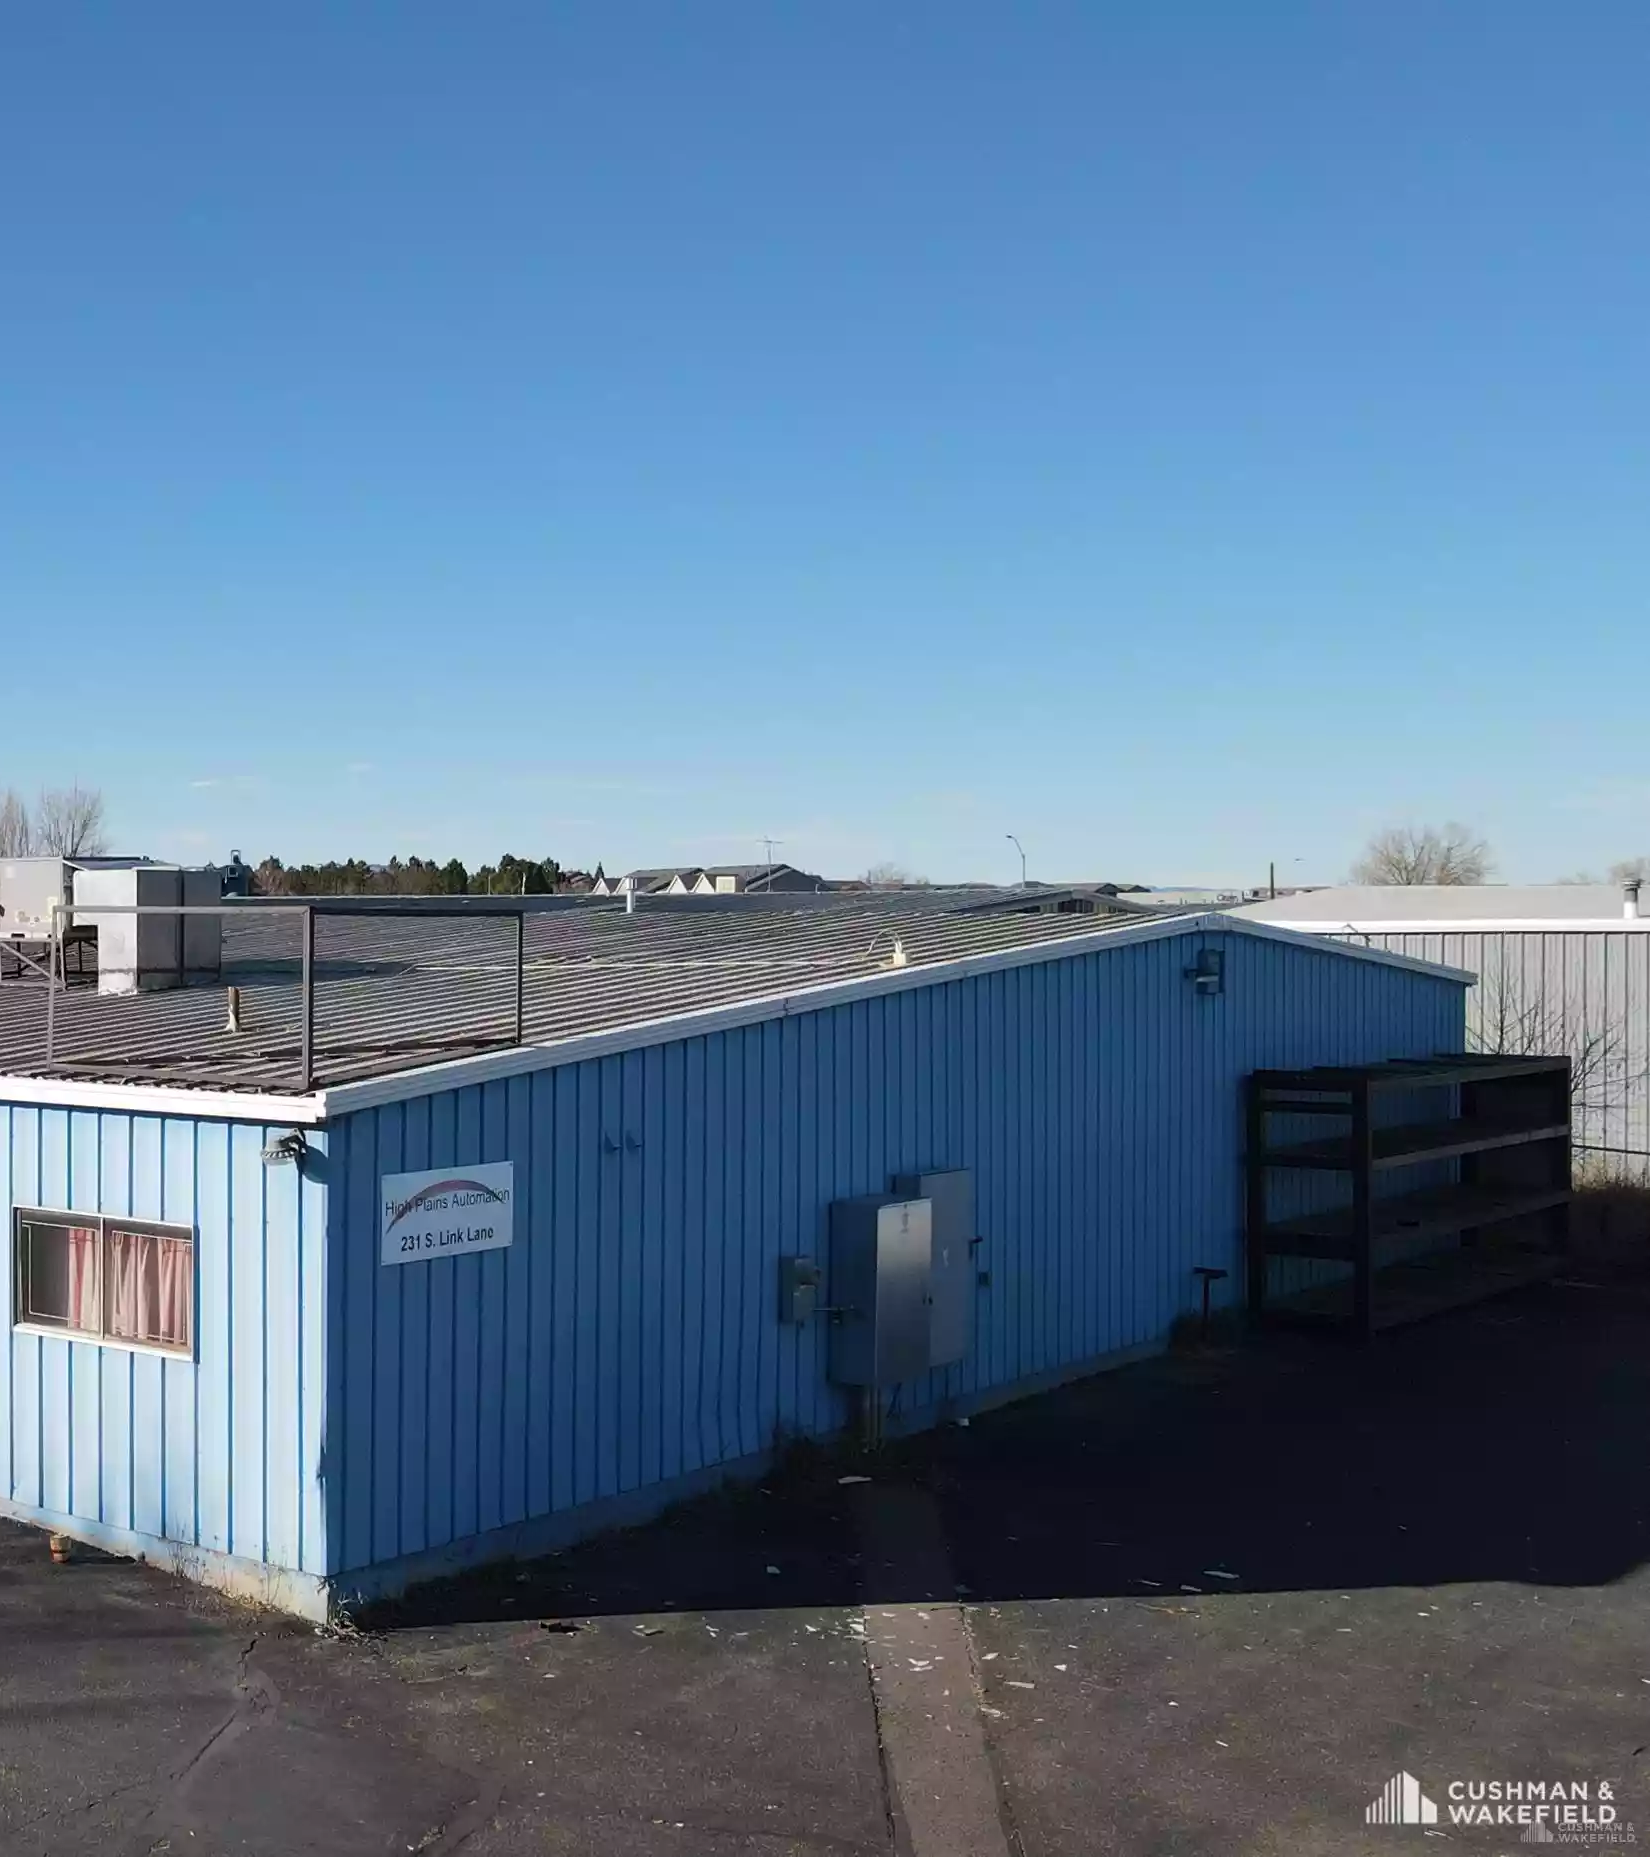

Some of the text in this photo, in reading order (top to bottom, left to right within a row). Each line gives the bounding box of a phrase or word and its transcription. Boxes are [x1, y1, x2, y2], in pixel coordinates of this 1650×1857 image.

[385, 1188, 510, 1218] High Plains Automation
[401, 1226, 494, 1252] 231 S. Link Lane
